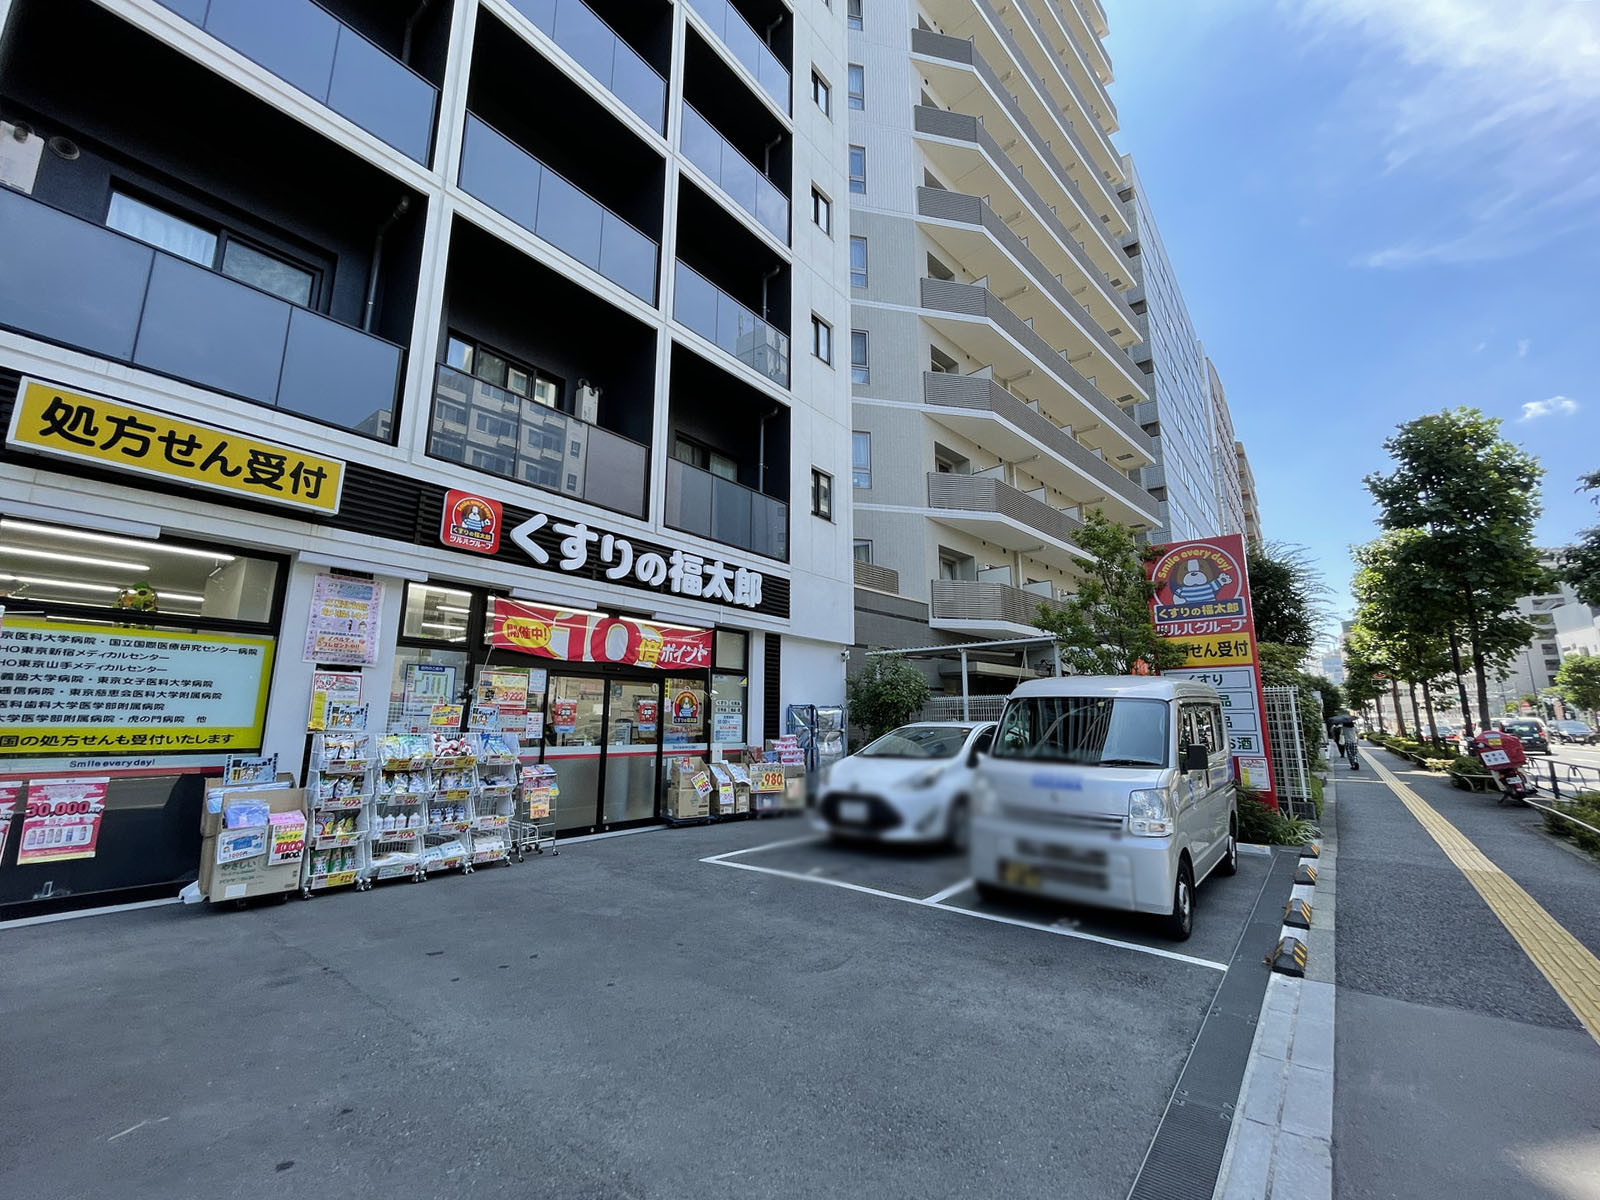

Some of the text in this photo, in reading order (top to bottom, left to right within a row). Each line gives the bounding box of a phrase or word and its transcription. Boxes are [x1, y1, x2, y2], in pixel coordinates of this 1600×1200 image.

[39, 396, 328, 499] 処方せん受付
[450, 535, 493, 550] ツルハグループ
[510, 513, 763, 608] くすりの福太郎
[1157, 549, 1232, 578] Smile every day!
[1159, 602, 1239, 619] くすりの福太郎
[507, 623, 547, 641] 開催中!
[0, 734, 235, 747] 国の処方せんも受付いたします
[70, 760, 101, 768] Smile
